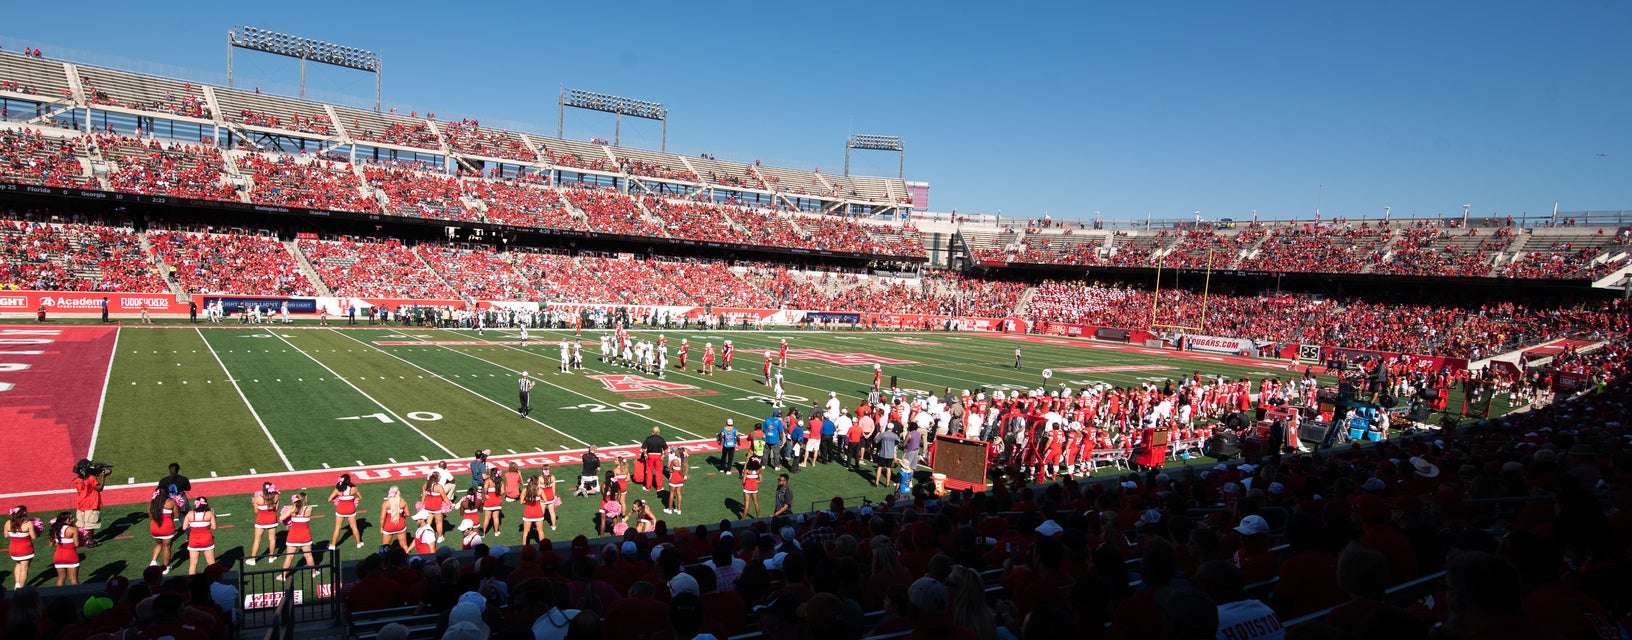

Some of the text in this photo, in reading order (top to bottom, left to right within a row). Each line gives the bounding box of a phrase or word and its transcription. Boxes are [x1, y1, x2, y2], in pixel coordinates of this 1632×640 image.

[81, 191, 106, 199] Georgia
[57, 297, 110, 306] Academ
[120, 297, 169, 307] FUDDRUCKERS
[1185, 338, 1239, 349] OUGARS.COM
[1301, 347, 1318, 358] 25
[361, 411, 443, 424] 10
[1221, 612, 1280, 640] HOUSTO
